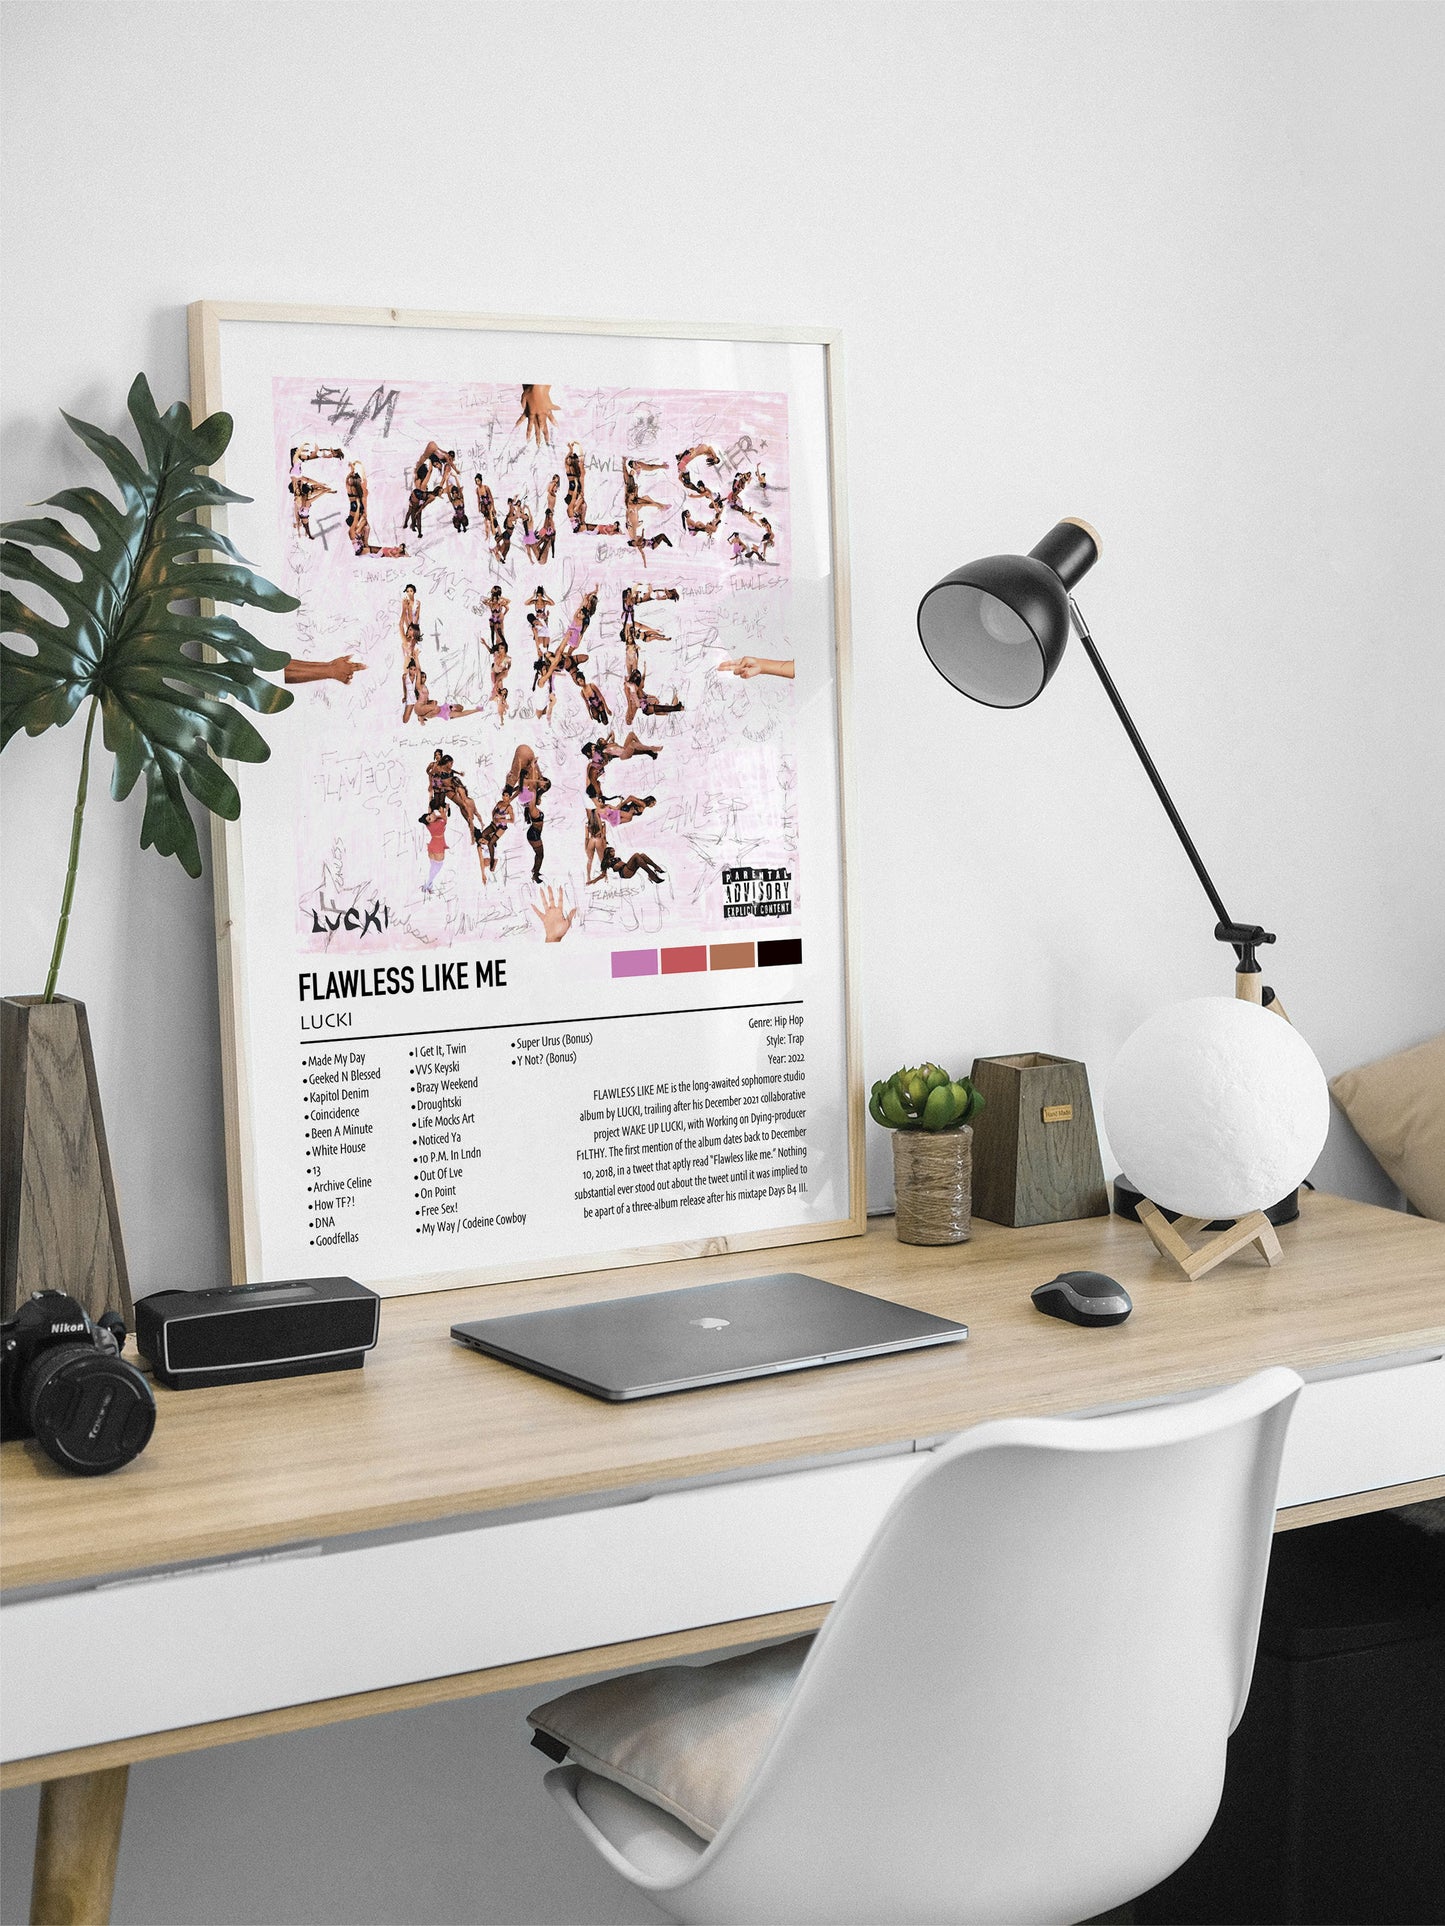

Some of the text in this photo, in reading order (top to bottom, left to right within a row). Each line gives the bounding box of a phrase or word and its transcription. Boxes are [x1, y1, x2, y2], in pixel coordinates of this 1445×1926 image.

[288, 440, 776, 568] FLAWLESS
[400, 583, 686, 726] LIKE
[418, 731, 666, 895] ME
[726, 870, 789, 883] PARENTAL
[726, 881, 789, 903] ADVISORY
[727, 903, 790, 917] EXPLICIT CONTENT
[312, 900, 389, 939] LUCKI
[298, 959, 507, 1002] FLAWLESS LIKE ME
[301, 1012, 352, 1030] LUCKI
[748, 1014, 804, 1029] Genre: Hip Hop
[516, 1032, 593, 1051] Super Urus (Bonus)
[766, 1033, 804, 1048] Style: Trap
[419, 1046, 434, 1057] Get
[436, 1045, 445, 1057] It,
[446, 1043, 466, 1055] Twin
[516, 1050, 577, 1066] Y Not? (Bonus)
[308, 1052, 365, 1067] Made My Day
[767, 1053, 805, 1064] Year: 2022
[308, 1067, 381, 1085] Geeked N Blessed
[434, 1060, 460, 1076] Keyski
[416, 1076, 478, 1094] Brazy Weekend
[593, 1070, 805, 1100] FLAWLESS LIKE ME is the long-awaited sophomore studio
[309, 1087, 369, 1105] Kapitol Denim
[417, 1095, 462, 1112] Droughtski
[310, 1106, 359, 1121] Coincidence
[579, 1089, 806, 1122] album by LUCKI, trailing after his December 2021 collaborative
[417, 1113, 475, 1129] Life Mocks Art
[593, 1108, 806, 1143] project WAKE UP LUCKI, with Working on Dying-producer
[311, 1124, 373, 1139] Been A Minute
[418, 1131, 461, 1146] Noticed Ya
[608, 1145, 623, 1157] The
[624, 1144, 640, 1155] first
[641, 1141, 673, 1154] mention
[674, 1138, 683, 1150] of
[684, 1138, 697, 1149] the
[697, 1136, 721, 1148] album
[723, 1134, 742, 1145] dates
[743, 1130, 760, 1143] back
[761, 1131, 769, 1141] to
[771, 1126, 807, 1140] December
[311, 1143, 366, 1157] White House
[419, 1146, 481, 1164] 10 P.M. In Lndn
[582, 1170, 594, 1180] 10,
[595, 1166, 616, 1178] 2018,
[617, 1165, 625, 1175] in
[626, 1166, 631, 1175] a
[632, 1162, 654, 1174] tweet
[655, 1159, 671, 1171] that
[672, 1157, 691, 1172] aptly
[692, 1155, 709, 1167] read
[745, 1150, 758, 1161] like
[777, 1145, 807, 1158] Nothing
[312, 1165, 321, 1177] 13
[419, 1167, 463, 1182] Out Of Lve
[313, 1176, 372, 1193] Archive Celine
[574, 1163, 808, 1200] substantial ever stood out about the tweet until it was implied to
[420, 1185, 456, 1199] On Point
[314, 1196, 355, 1211] How TF?!
[421, 1202, 458, 1216] Free Sex!
[583, 1207, 593, 1219] be
[594, 1205, 615, 1219] apart
[616, 1202, 624, 1215] of
[625, 1204, 630, 1213] a
[631, 1198, 678, 1212] three-album
[680, 1195, 705, 1207] release
[706, 1192, 724, 1204] after
[725, 1190, 736, 1201] his
[738, 1188, 767, 1200] mixtape
[768, 1186, 786, 1198] Days
[786, 1183, 797, 1195] B4
[315, 1216, 335, 1229] DNA
[421, 1223, 435, 1236] My
[436, 1221, 455, 1234] Way
[462, 1216, 494, 1229] Codeine
[495, 1212, 526, 1225] Cowboy
[315, 1231, 359, 1246] Goodfellas
[51, 1323, 84, 1333] Nikon
